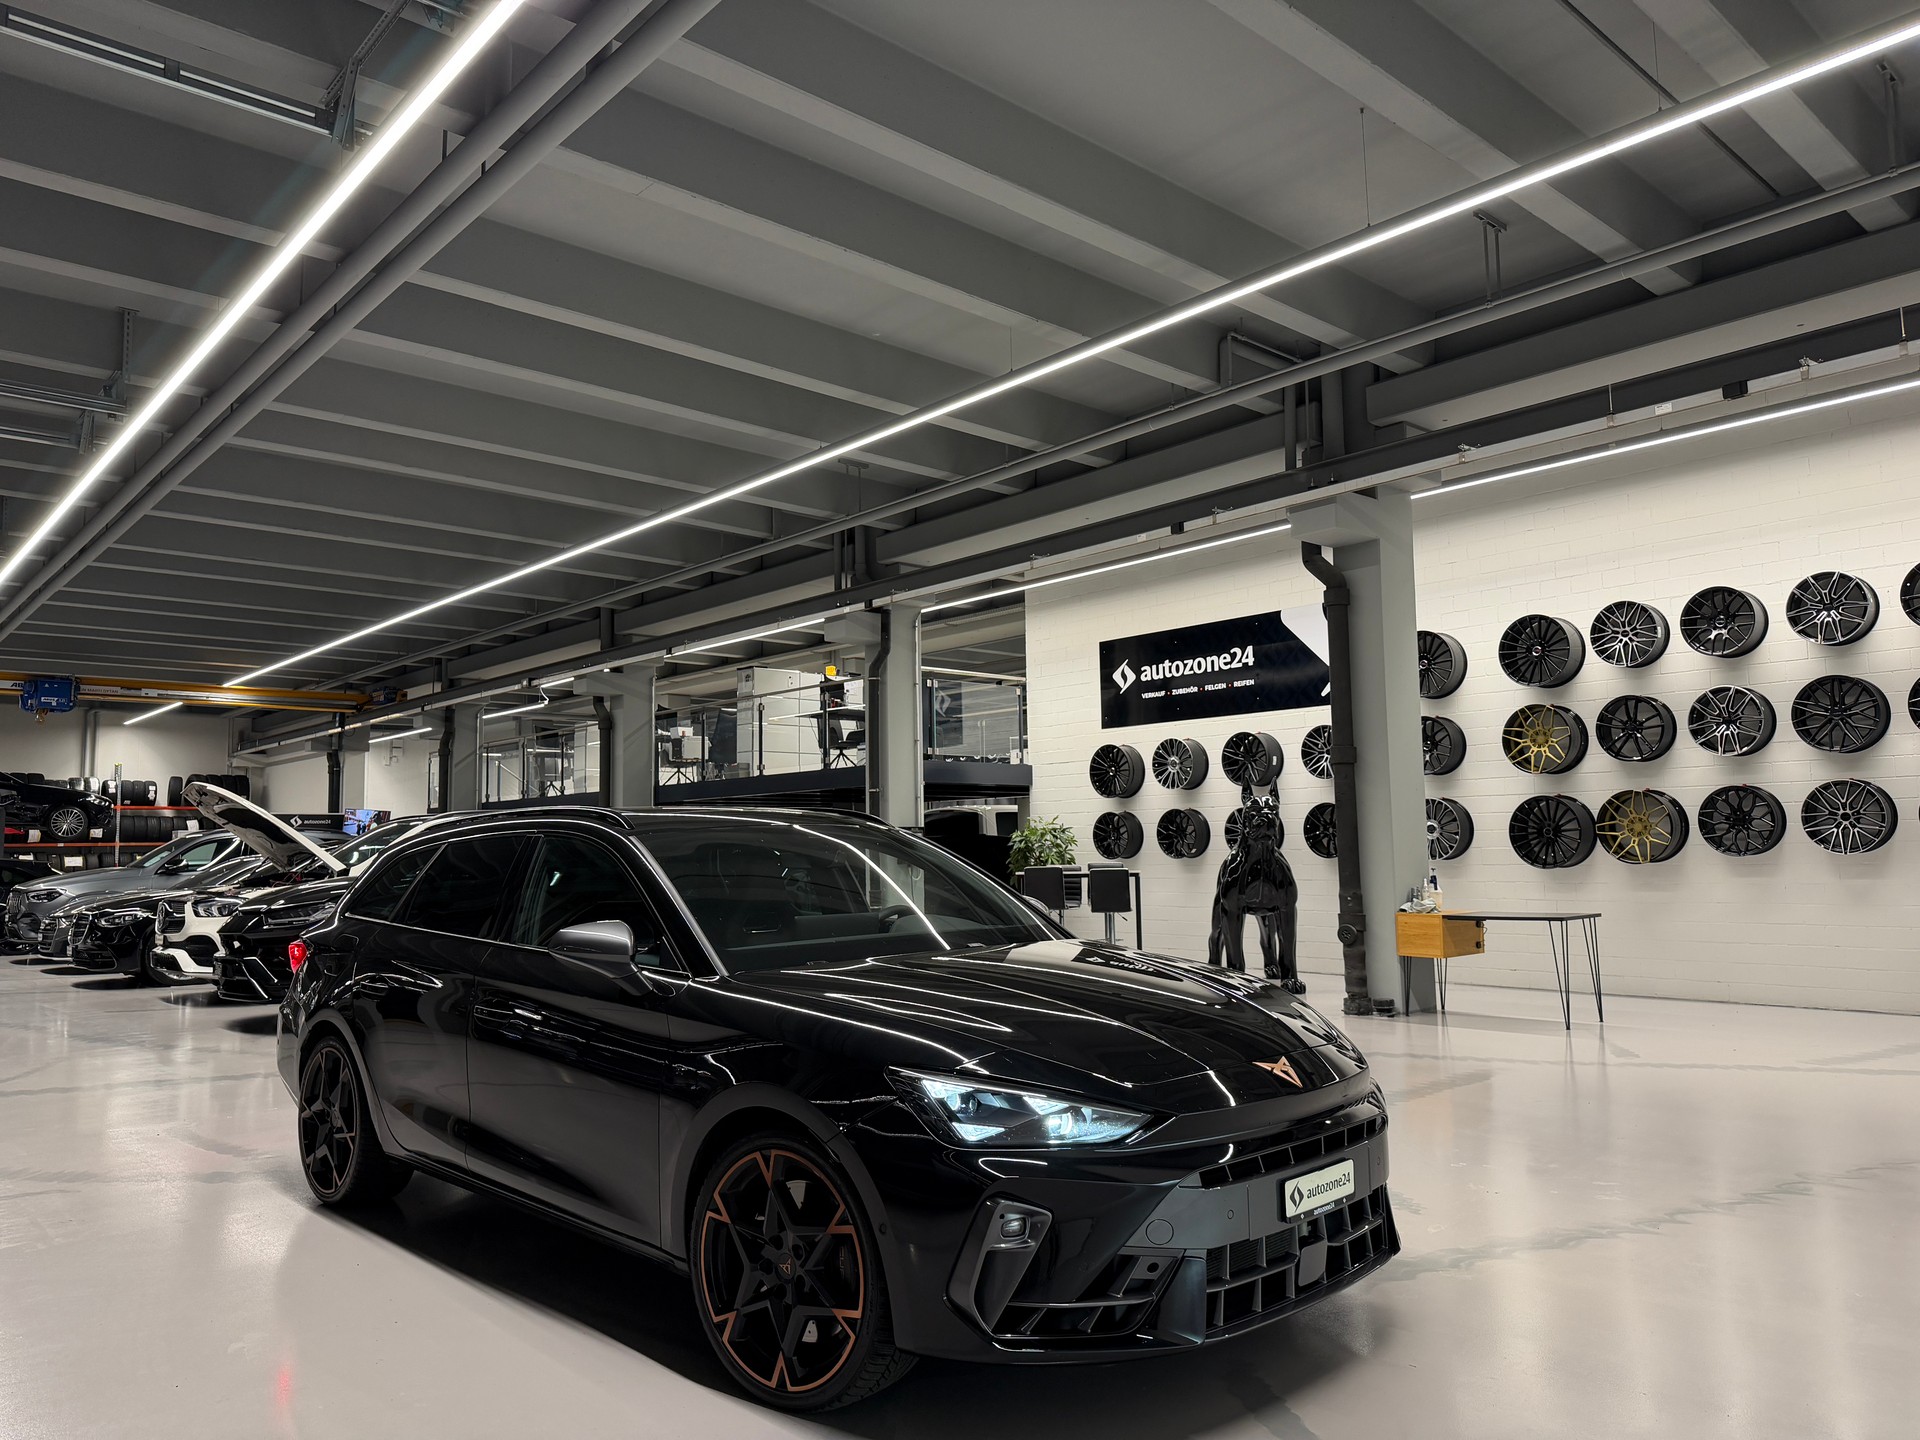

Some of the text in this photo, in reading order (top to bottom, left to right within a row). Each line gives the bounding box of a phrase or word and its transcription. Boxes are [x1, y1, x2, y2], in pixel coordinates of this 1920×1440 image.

[1140, 645, 1255, 681] autozone24
[1141, 679, 1255, 699] VERKAUF ZUBEHÖR FELGEN REIFEN
[1307, 1172, 1350, 1198] autozone24
